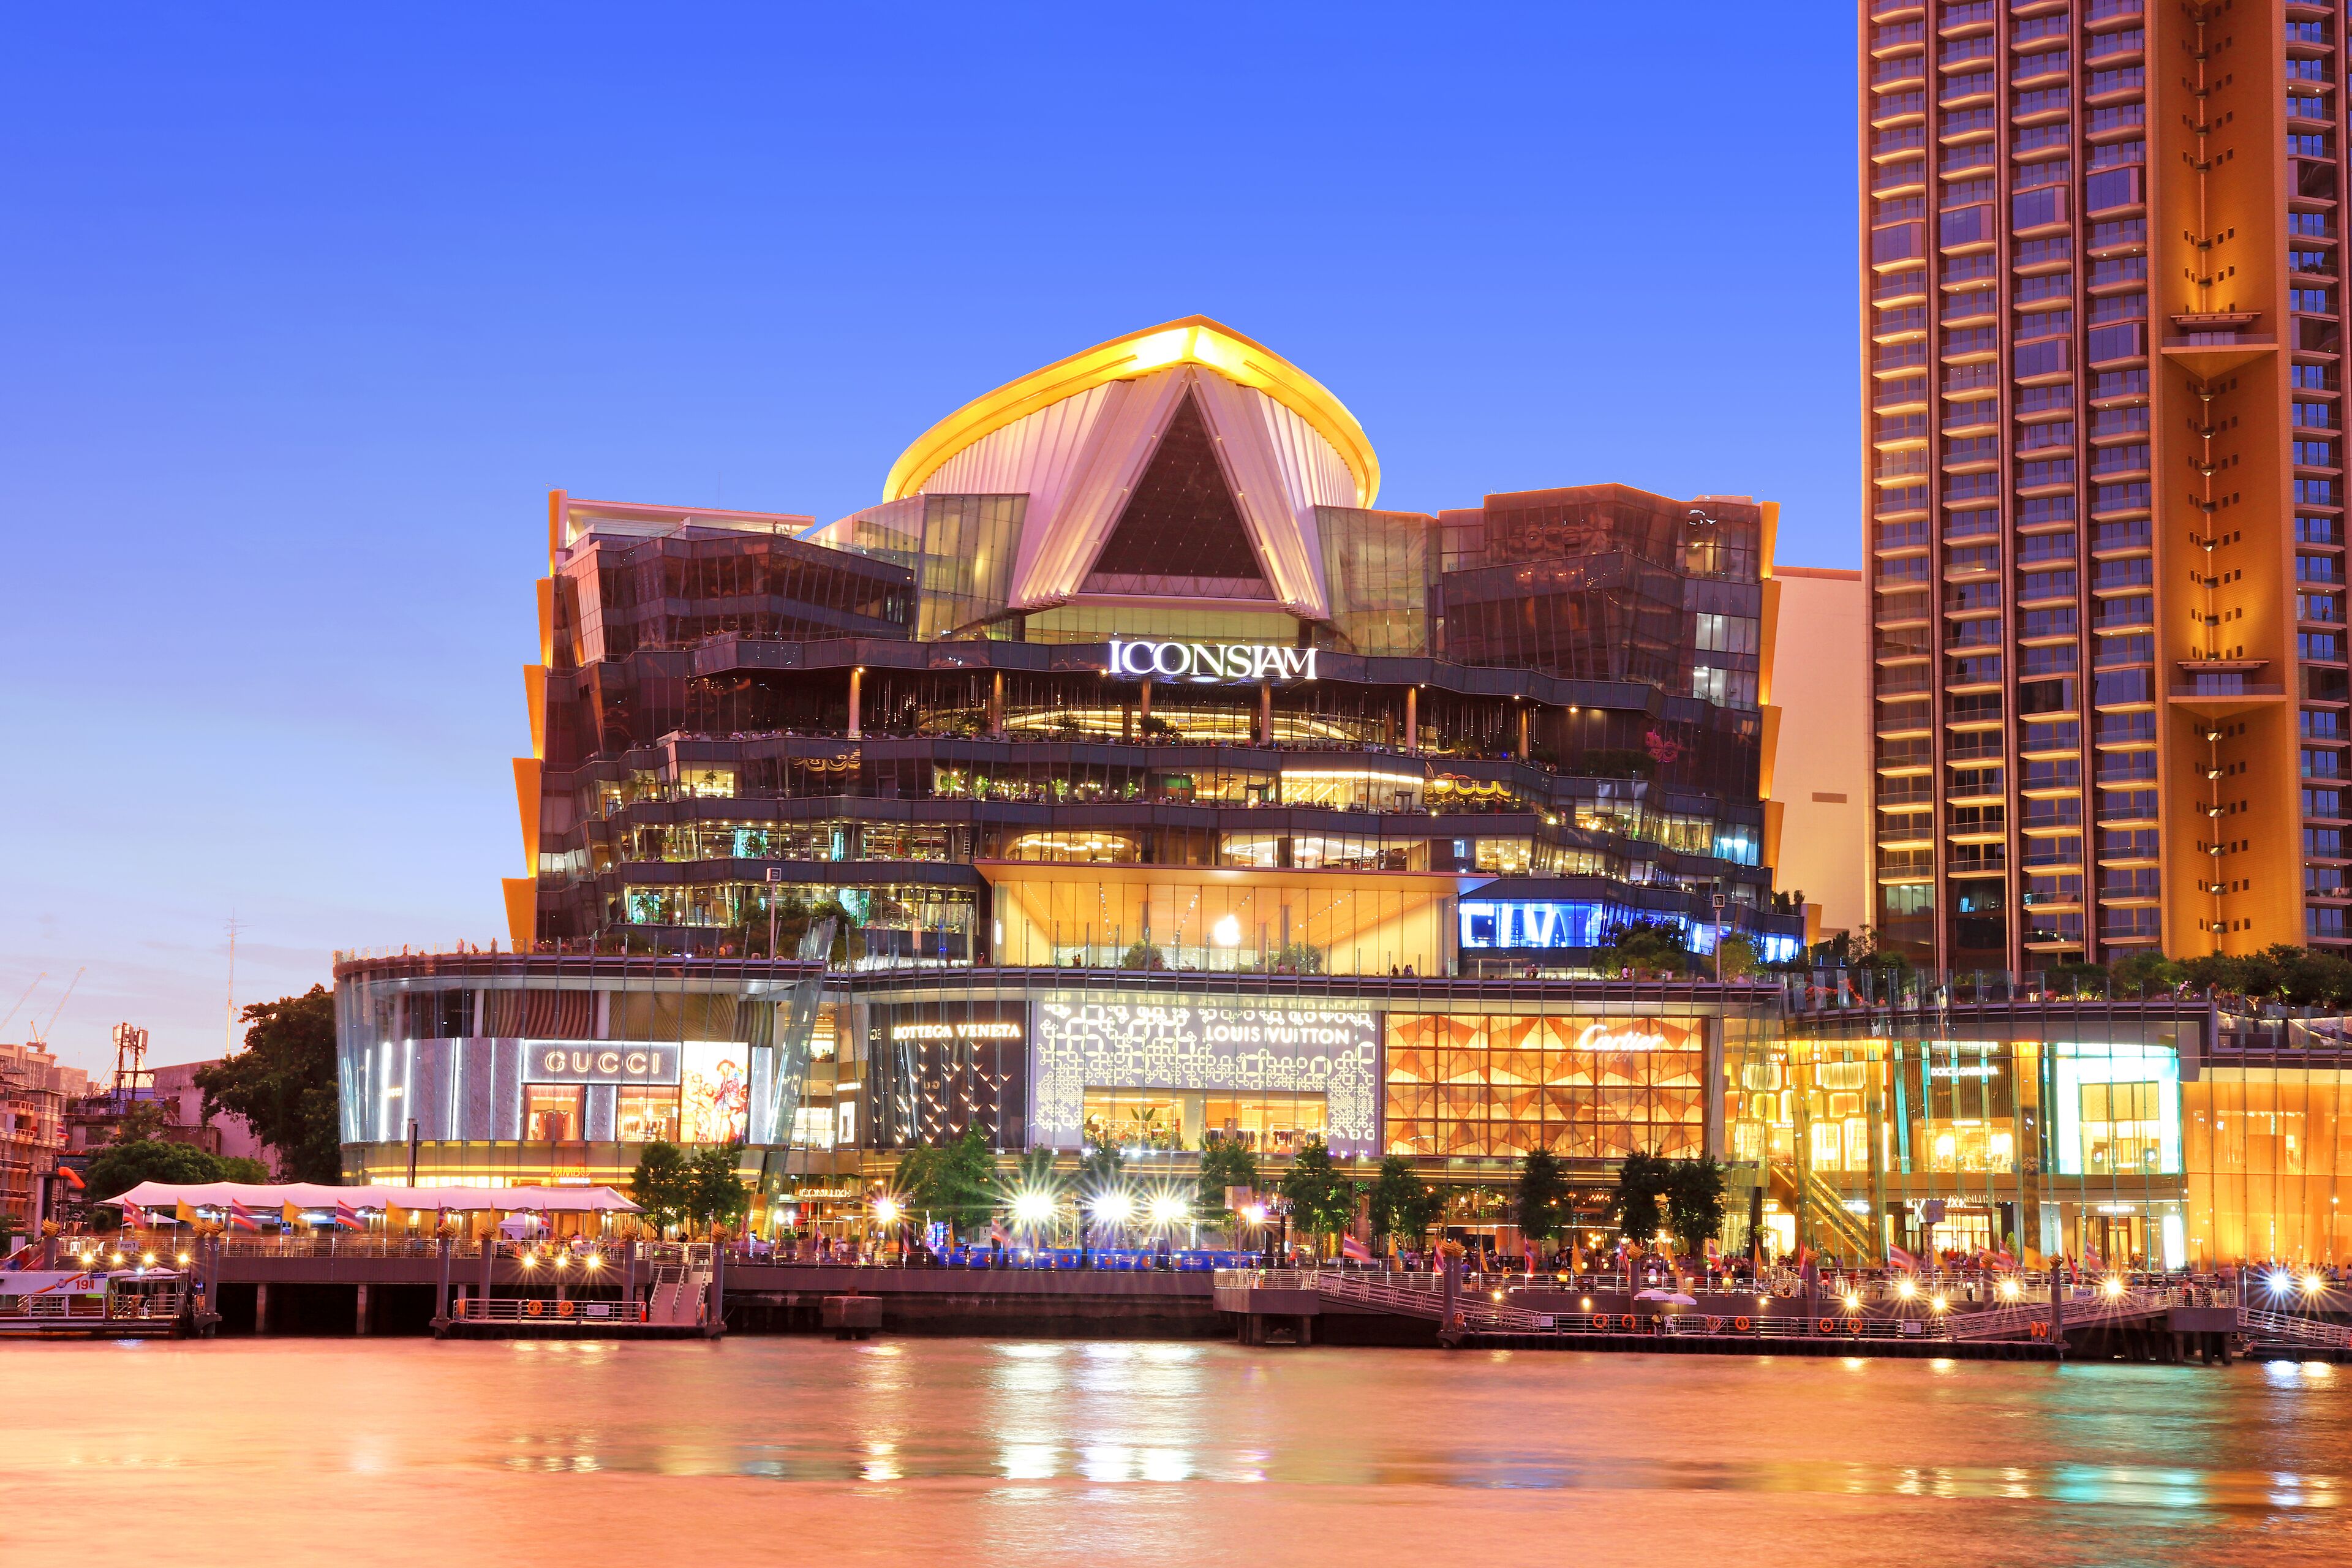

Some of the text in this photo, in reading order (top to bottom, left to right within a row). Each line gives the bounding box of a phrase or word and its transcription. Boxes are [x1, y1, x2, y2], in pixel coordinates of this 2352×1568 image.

[1109, 641, 1319, 680] ICONSIAM
[893, 1025, 952, 1039] BOTTEGA
[956, 1024, 1020, 1038] VENETA
[1205, 1025, 1349, 1044] LOUIS VUITTON
[1580, 1025, 1664, 1050] Cartier
[545, 1051, 660, 1074] GUCCI
[75, 1280, 94, 1289] 191
